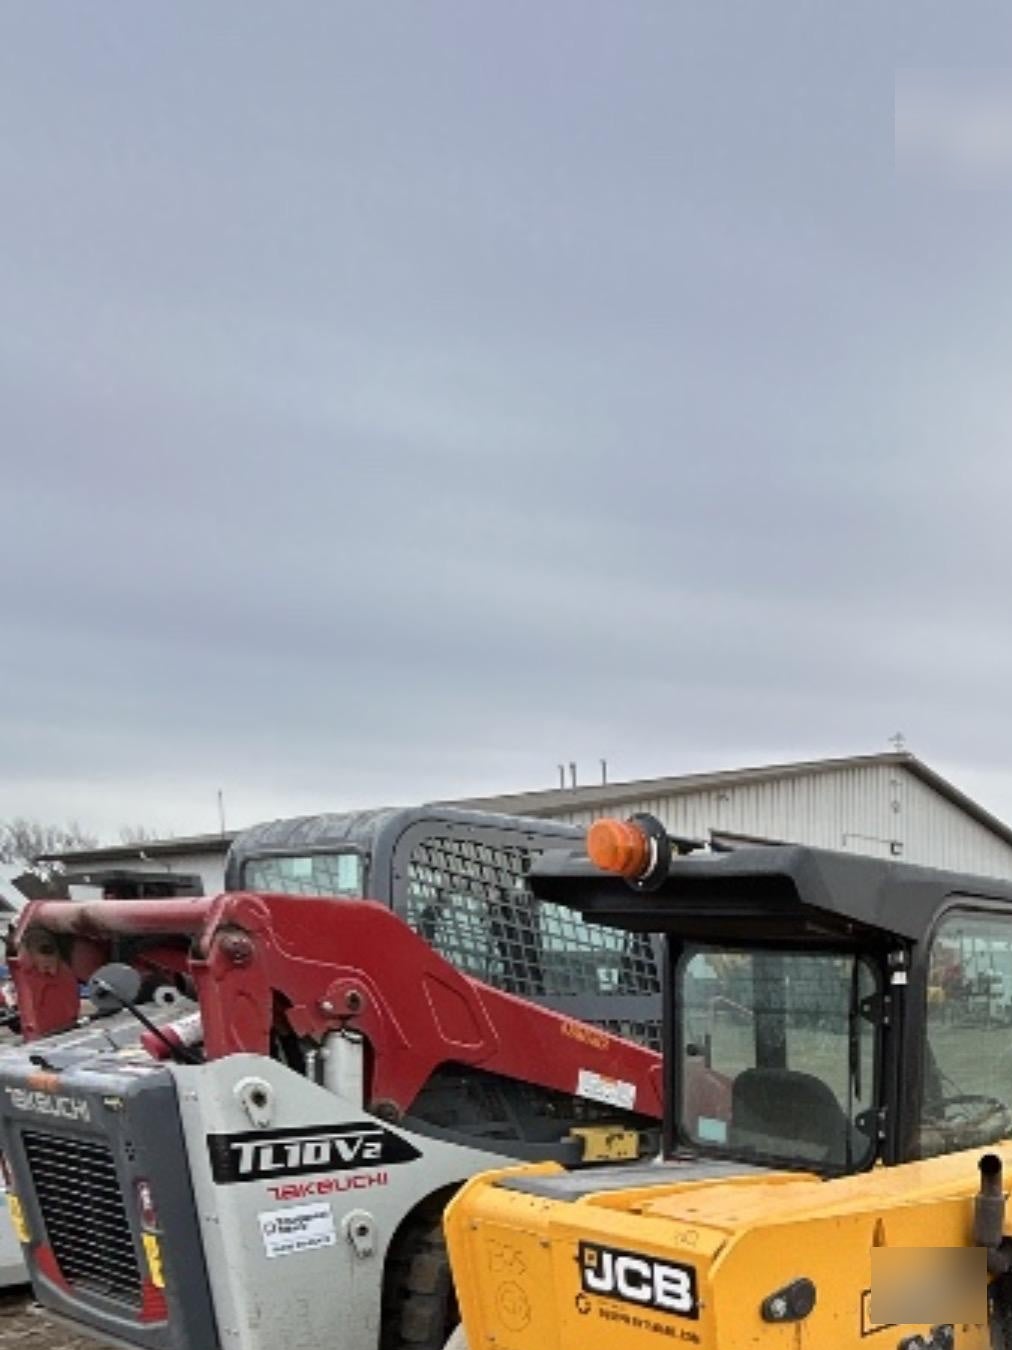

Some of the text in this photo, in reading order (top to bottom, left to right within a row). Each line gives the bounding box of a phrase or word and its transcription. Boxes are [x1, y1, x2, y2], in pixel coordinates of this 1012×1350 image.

[230, 1134, 383, 1174] TL10V2
[266, 1172, 388, 1200] TAKEUCHI
[584, 1251, 693, 1312] JCB
